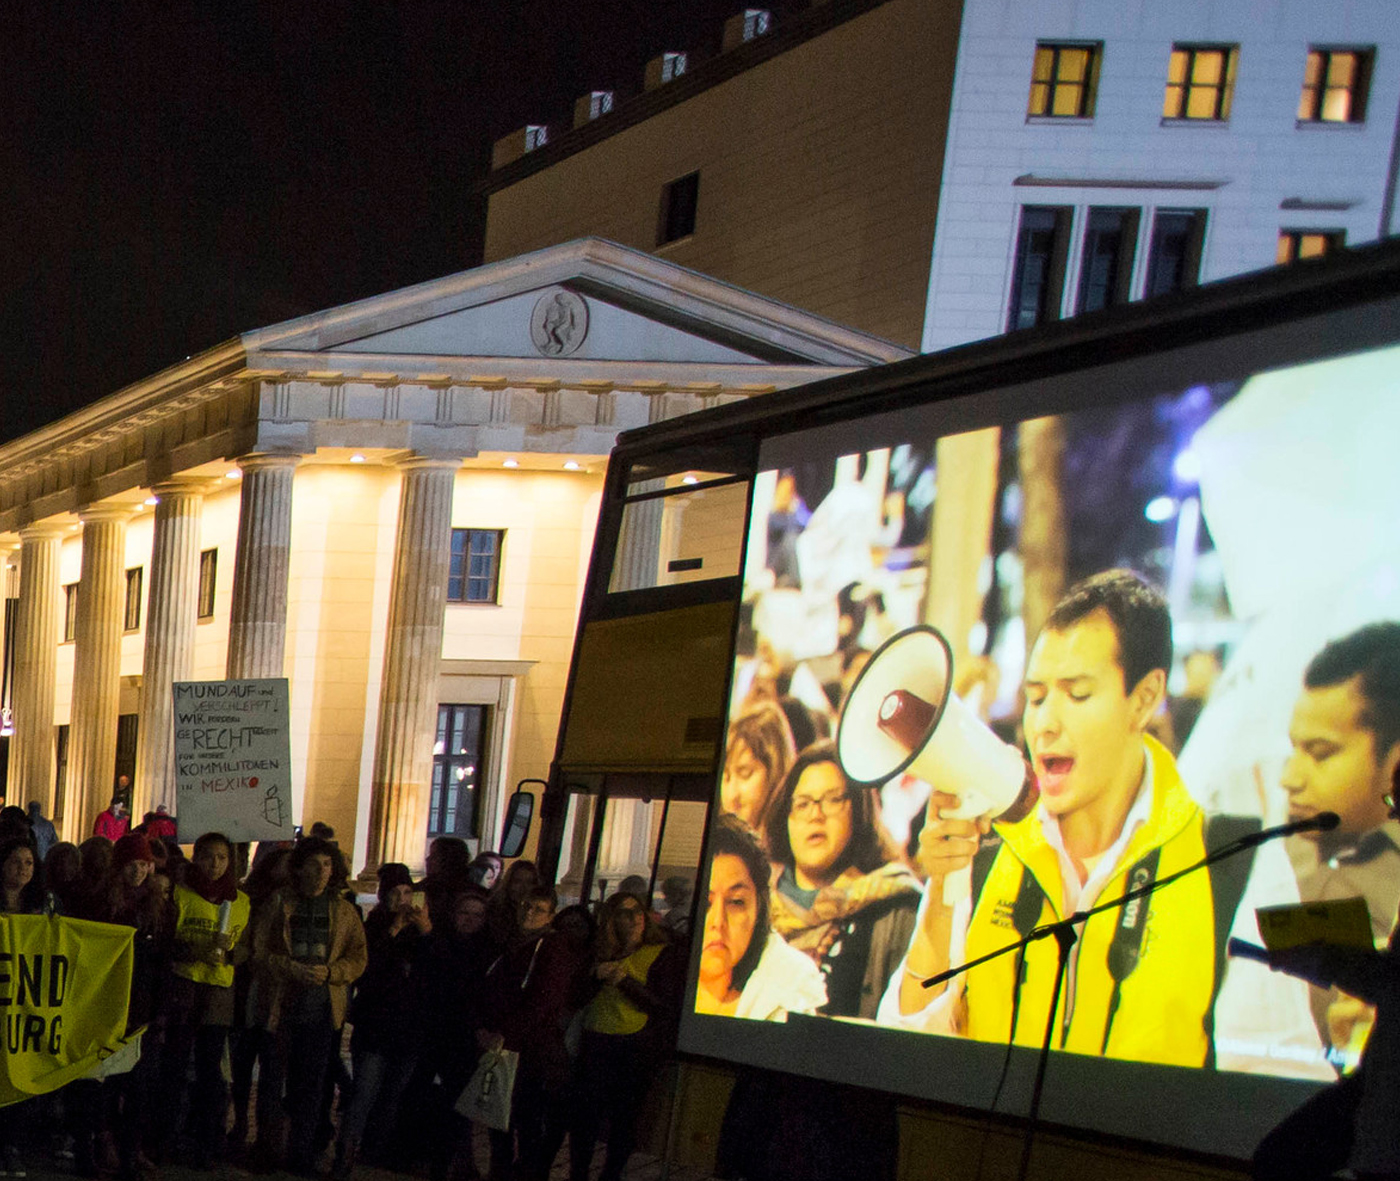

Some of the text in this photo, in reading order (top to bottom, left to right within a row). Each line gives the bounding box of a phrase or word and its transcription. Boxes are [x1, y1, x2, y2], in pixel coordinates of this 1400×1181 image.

[179, 713, 204, 725] WIR
[179, 759, 279, 777] KOMMILITONEN
[201, 776, 259, 794] MEXIKO
